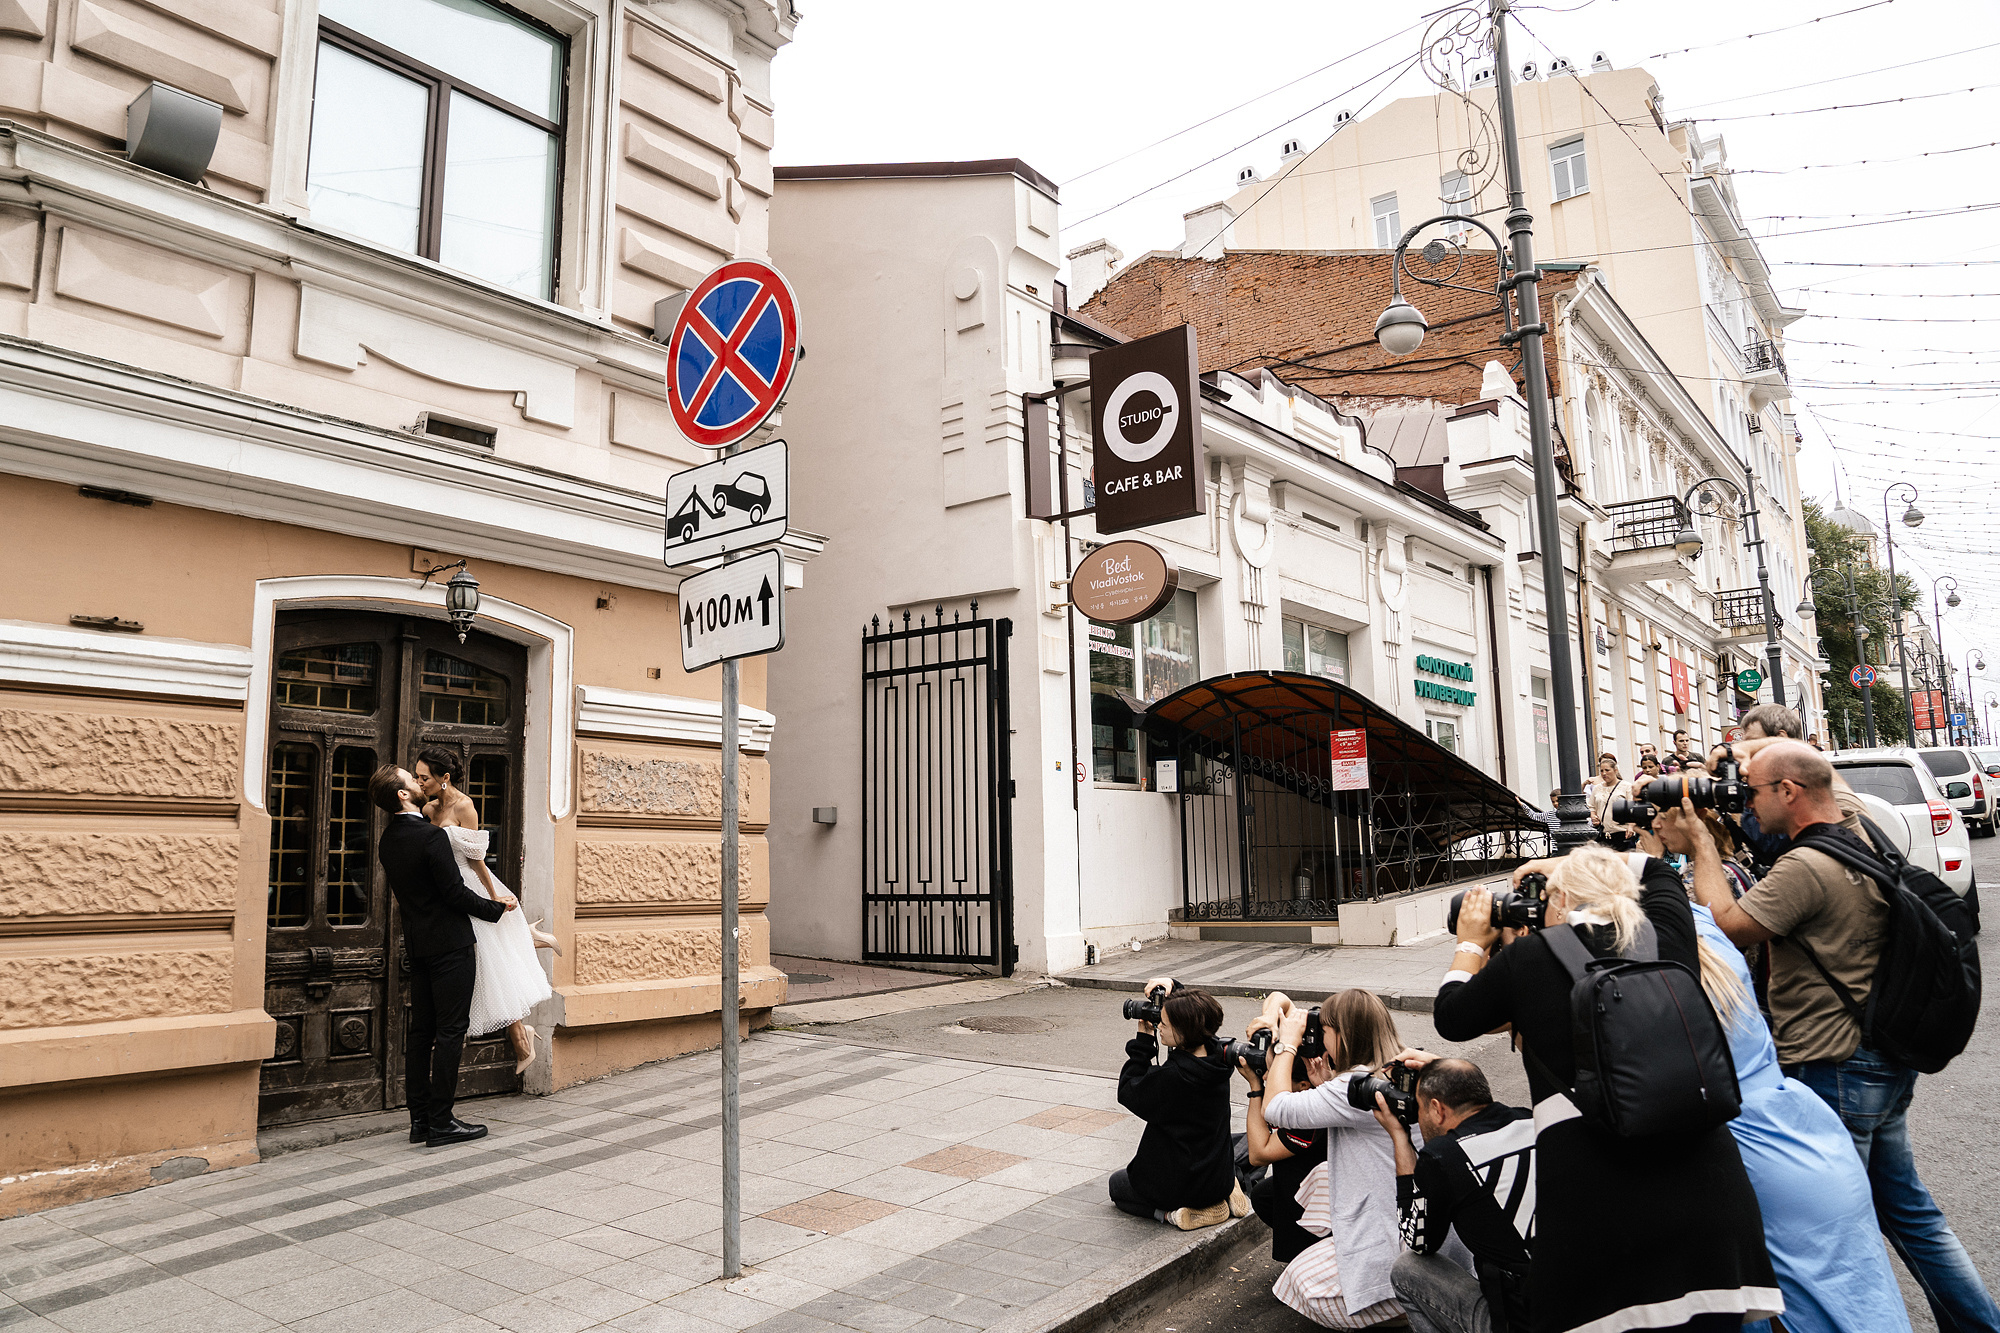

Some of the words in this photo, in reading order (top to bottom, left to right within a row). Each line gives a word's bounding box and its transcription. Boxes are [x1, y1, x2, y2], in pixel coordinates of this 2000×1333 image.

[1120, 407, 1161, 428] STUDIO
[1104, 475, 1139, 496] CAFE
[1142, 472, 1153, 487] &
[1156, 465, 1183, 484] BAR
[1101, 555, 1131, 575] Best
[1416, 654, 1473, 682] ФЛОТСКИЙ
[1414, 680, 1477, 707] УНИВЕРМАГ
[1954, 714, 1963, 725] P
